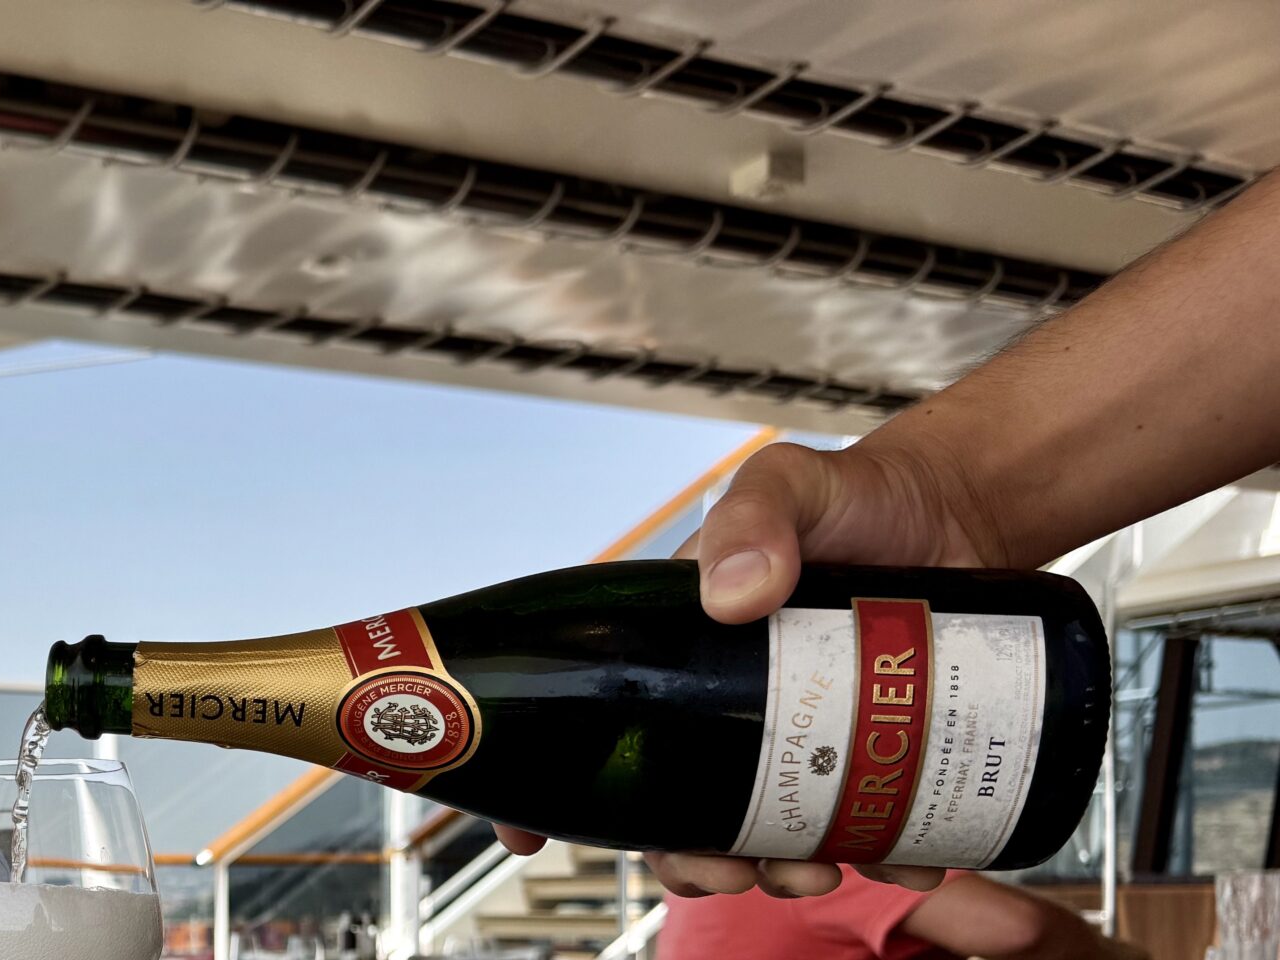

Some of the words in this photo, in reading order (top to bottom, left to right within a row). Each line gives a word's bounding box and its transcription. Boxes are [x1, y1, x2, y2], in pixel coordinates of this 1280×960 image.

[380, 683, 432, 697] MERCIER
[949, 664, 960, 699] 1858
[148, 692, 305, 728] MERCIER
[445, 711, 461, 747] 1858
[949, 709, 957, 728] EN
[964, 702, 980, 753] FRANCE
[778, 669, 836, 833] CHAMPAGNE
[839, 647, 916, 852] MERCIER
[932, 736, 954, 796] FONDÉE
[977, 736, 1006, 798] BRUT
[912, 802, 937, 846] MAISON
